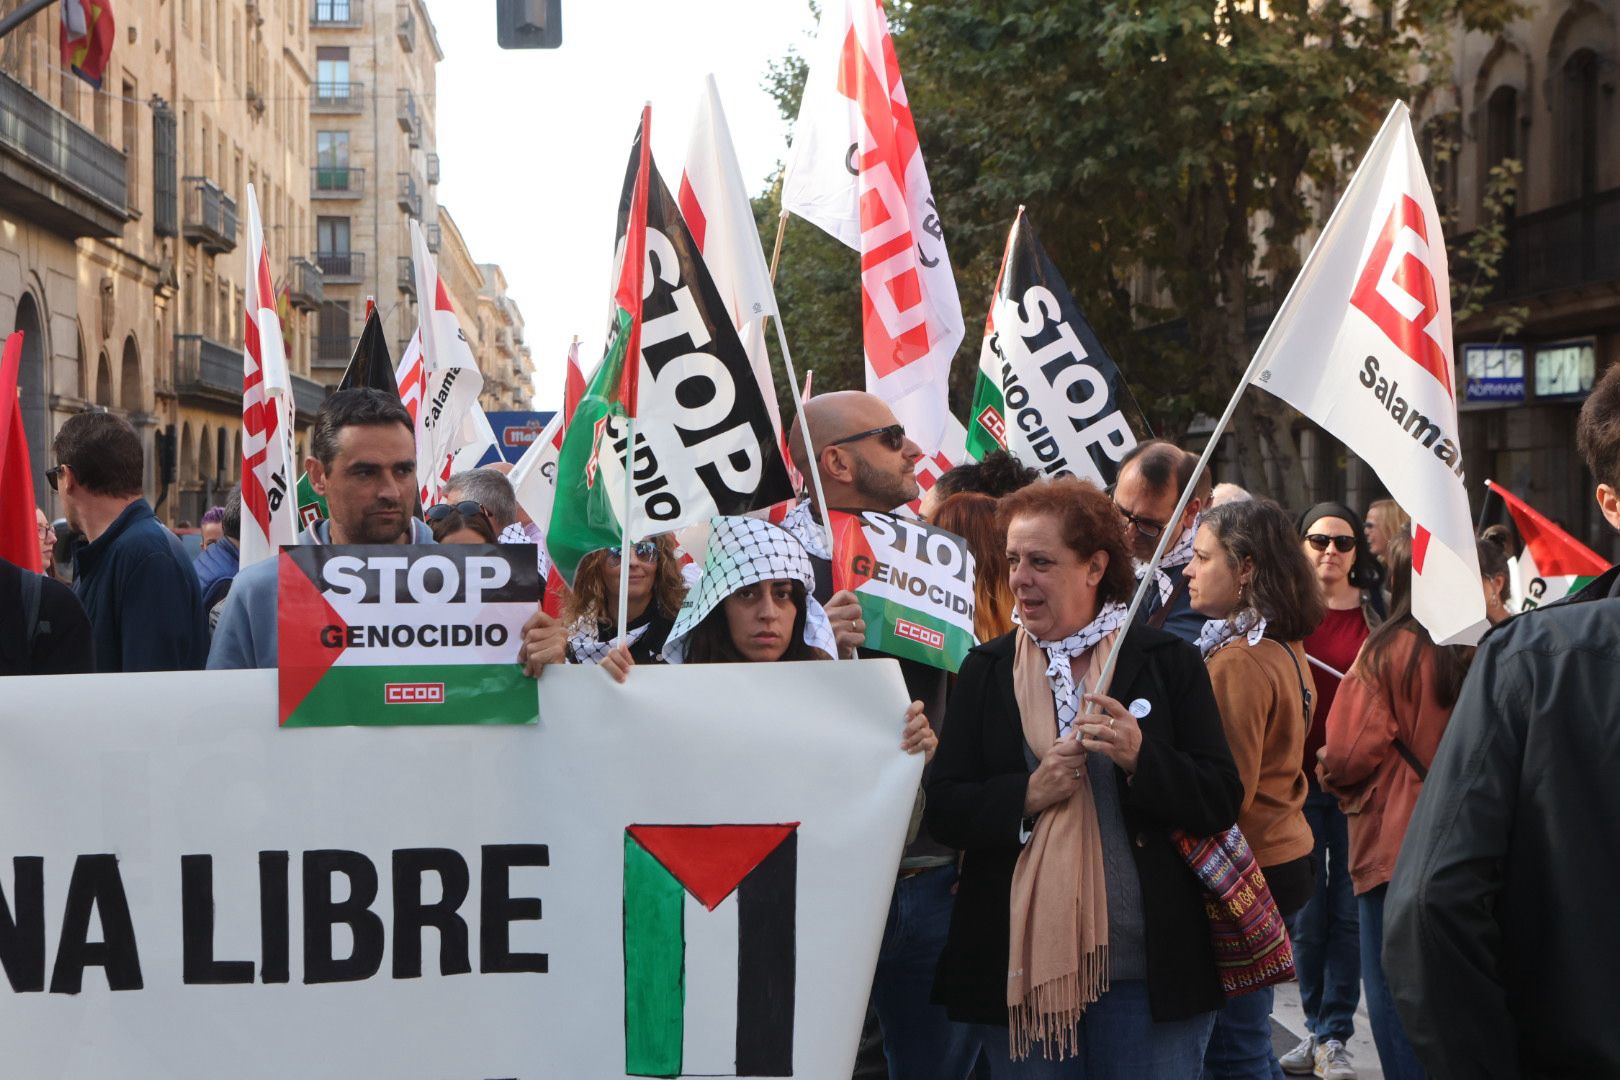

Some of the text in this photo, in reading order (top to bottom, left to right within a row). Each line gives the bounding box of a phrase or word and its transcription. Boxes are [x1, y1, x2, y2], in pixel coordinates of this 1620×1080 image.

[614, 226, 764, 495] STOP
[1018, 285, 1138, 465] STOP
[989, 331, 1077, 479] GNOCIDI
[606, 412, 682, 521] CIDIO
[322, 555, 512, 604] STOP
[852, 555, 973, 621] GENOCIDI
[320, 623, 508, 649] GENOCIDIO
[898, 622, 942, 645] CCOO
[388, 686, 441, 701] CCOO
[180, 843, 550, 985] LIBRE
